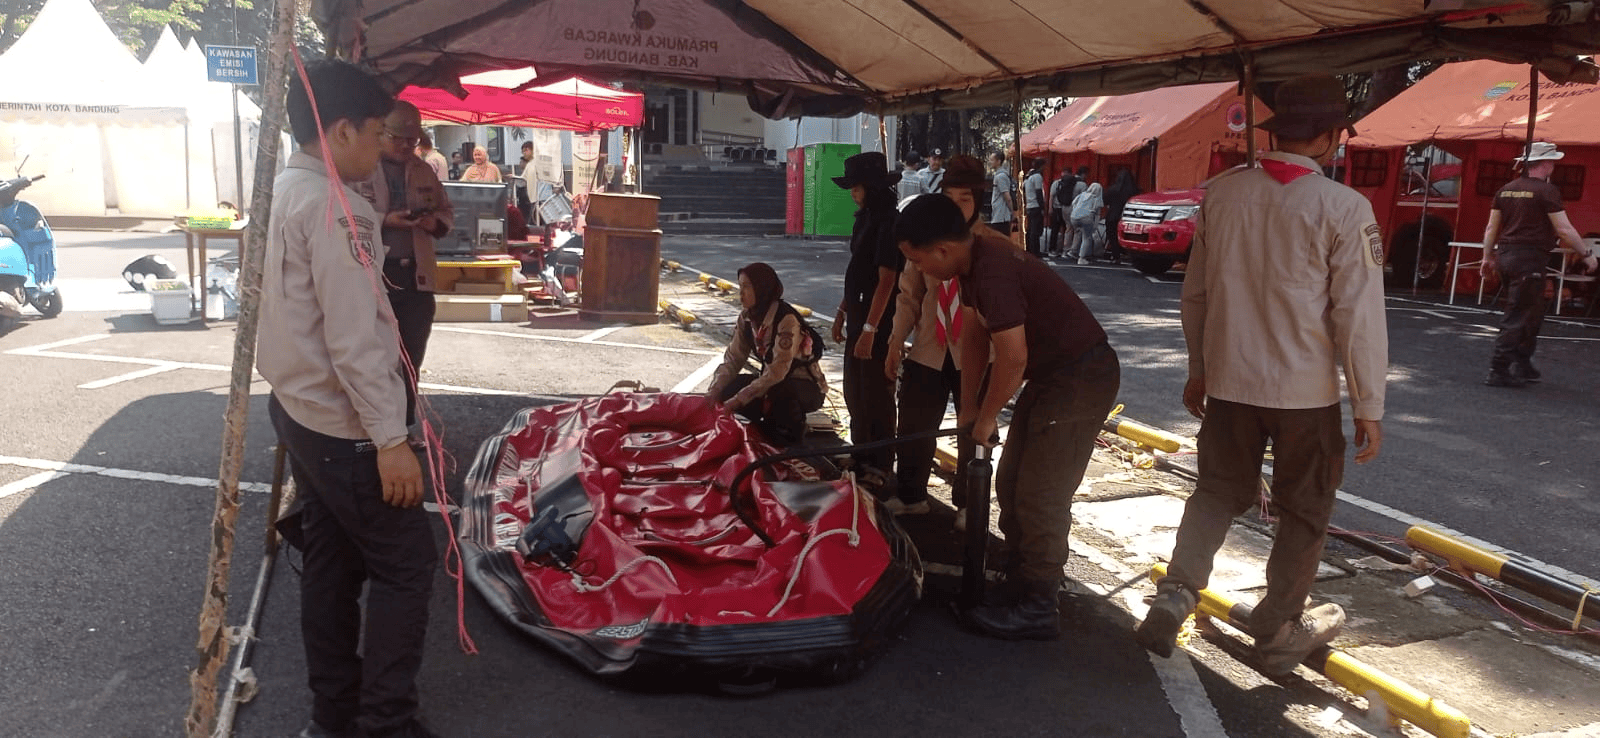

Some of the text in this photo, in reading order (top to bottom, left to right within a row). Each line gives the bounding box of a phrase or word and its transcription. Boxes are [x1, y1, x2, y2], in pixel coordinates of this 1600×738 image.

[209, 48, 253, 59] KAWASAN
[220, 59, 244, 68] EMISI
[216, 68, 248, 77] BERSIH
[0, 102, 120, 115] ERINTAH KOTA BANDUNG
